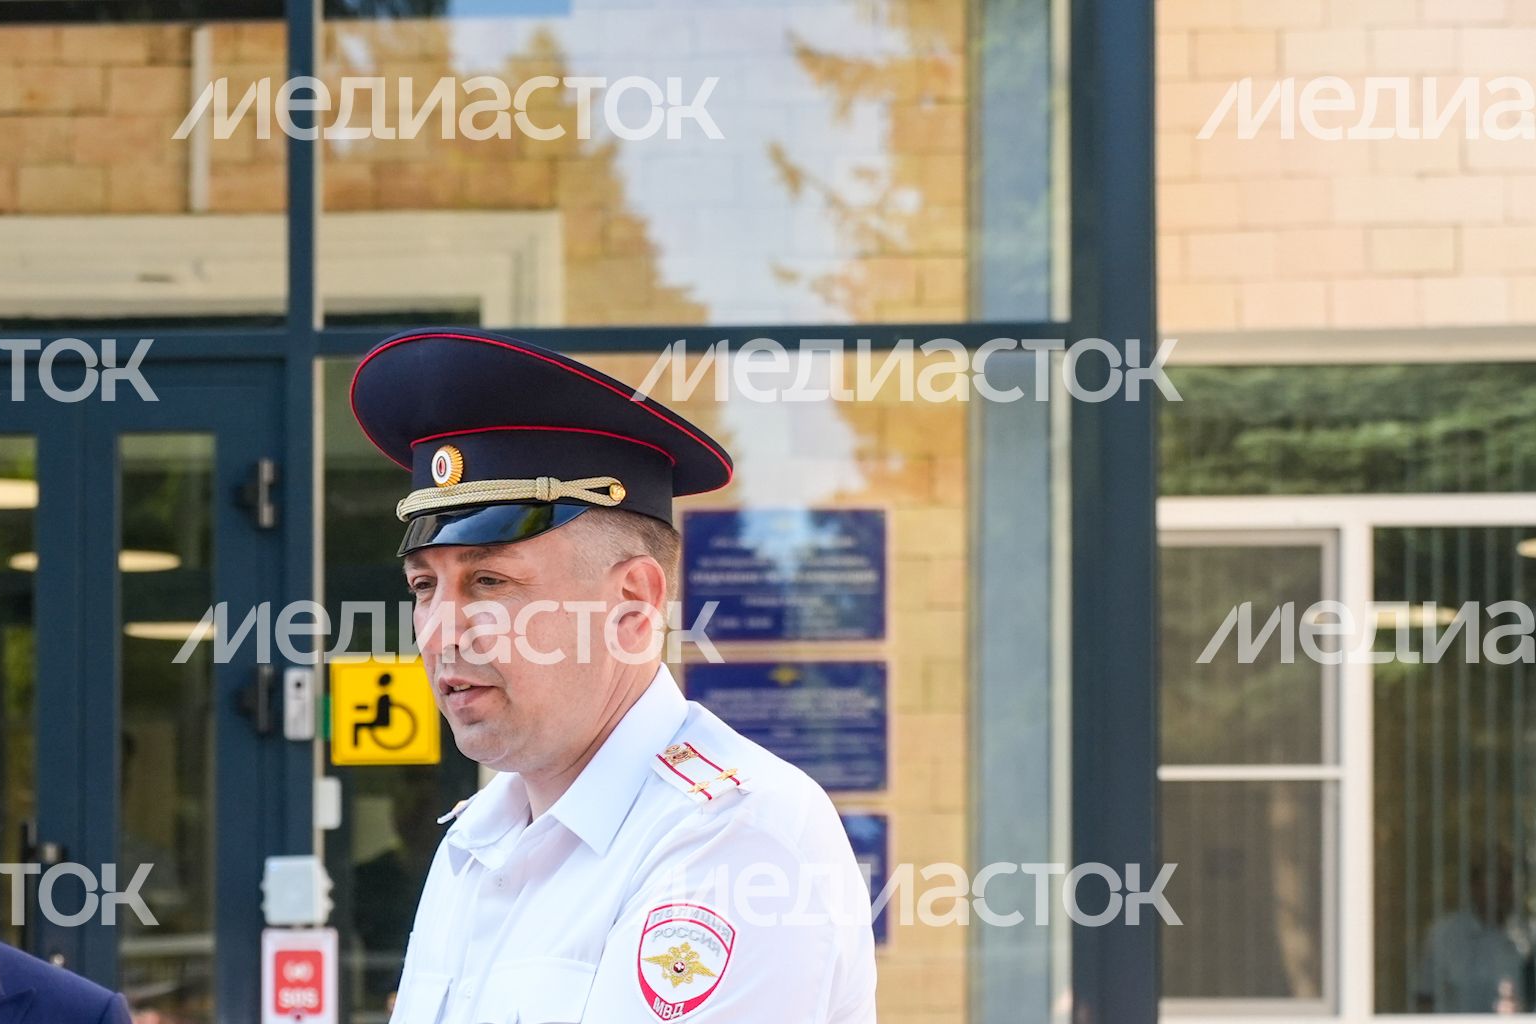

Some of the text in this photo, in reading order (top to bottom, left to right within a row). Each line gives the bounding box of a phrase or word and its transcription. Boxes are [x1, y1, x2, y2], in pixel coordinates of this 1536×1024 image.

[650, 908, 732, 942] ПОЛИЦИЯ
[652, 926, 722, 957] РОССИЯ
[652, 997, 686, 1020] МВД
